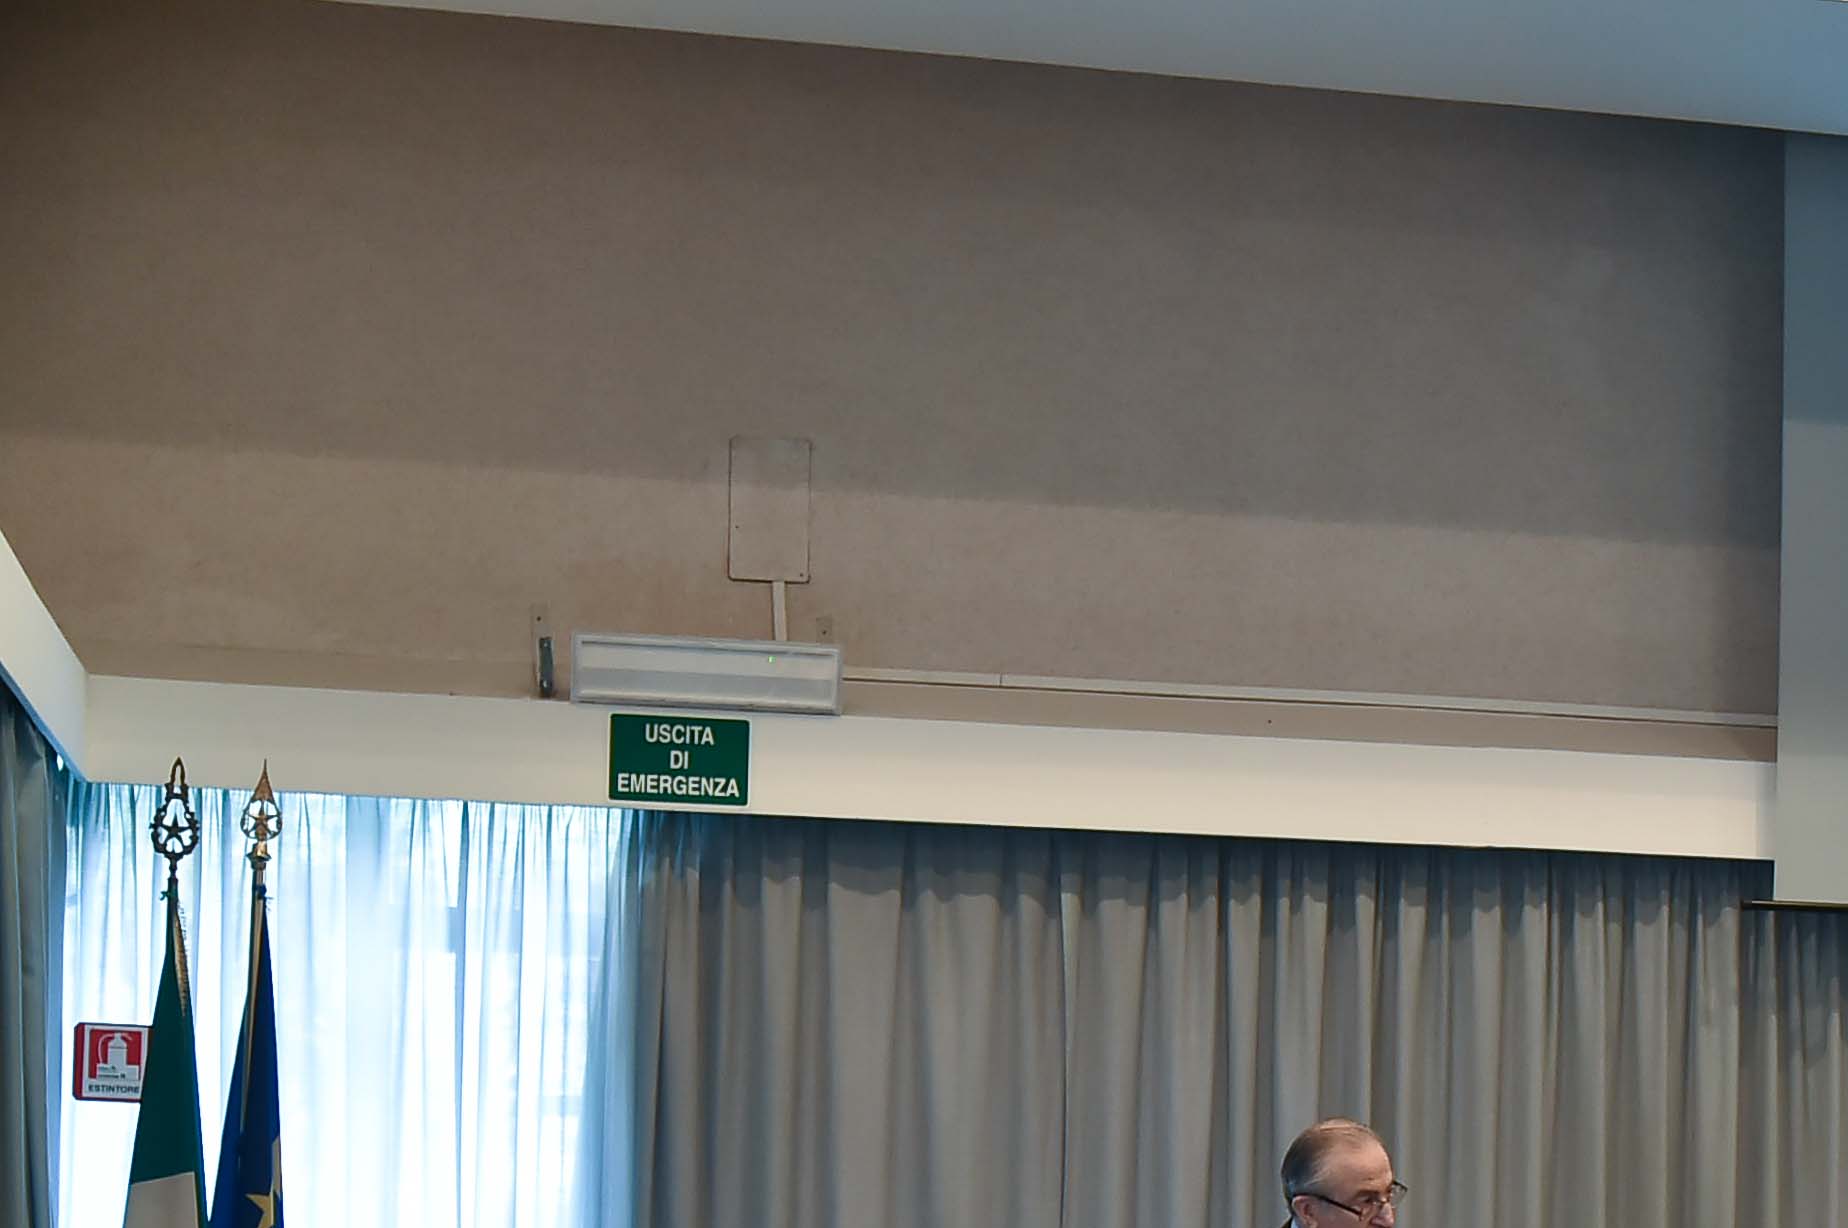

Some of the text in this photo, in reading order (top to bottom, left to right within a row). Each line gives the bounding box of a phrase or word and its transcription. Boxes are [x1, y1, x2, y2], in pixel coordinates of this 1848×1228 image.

[645, 723, 714, 746] USCITA
[669, 750, 688, 770] DI
[617, 773, 739, 798] EMERGENZA
[88, 1084, 140, 1094] ESTINTORE
